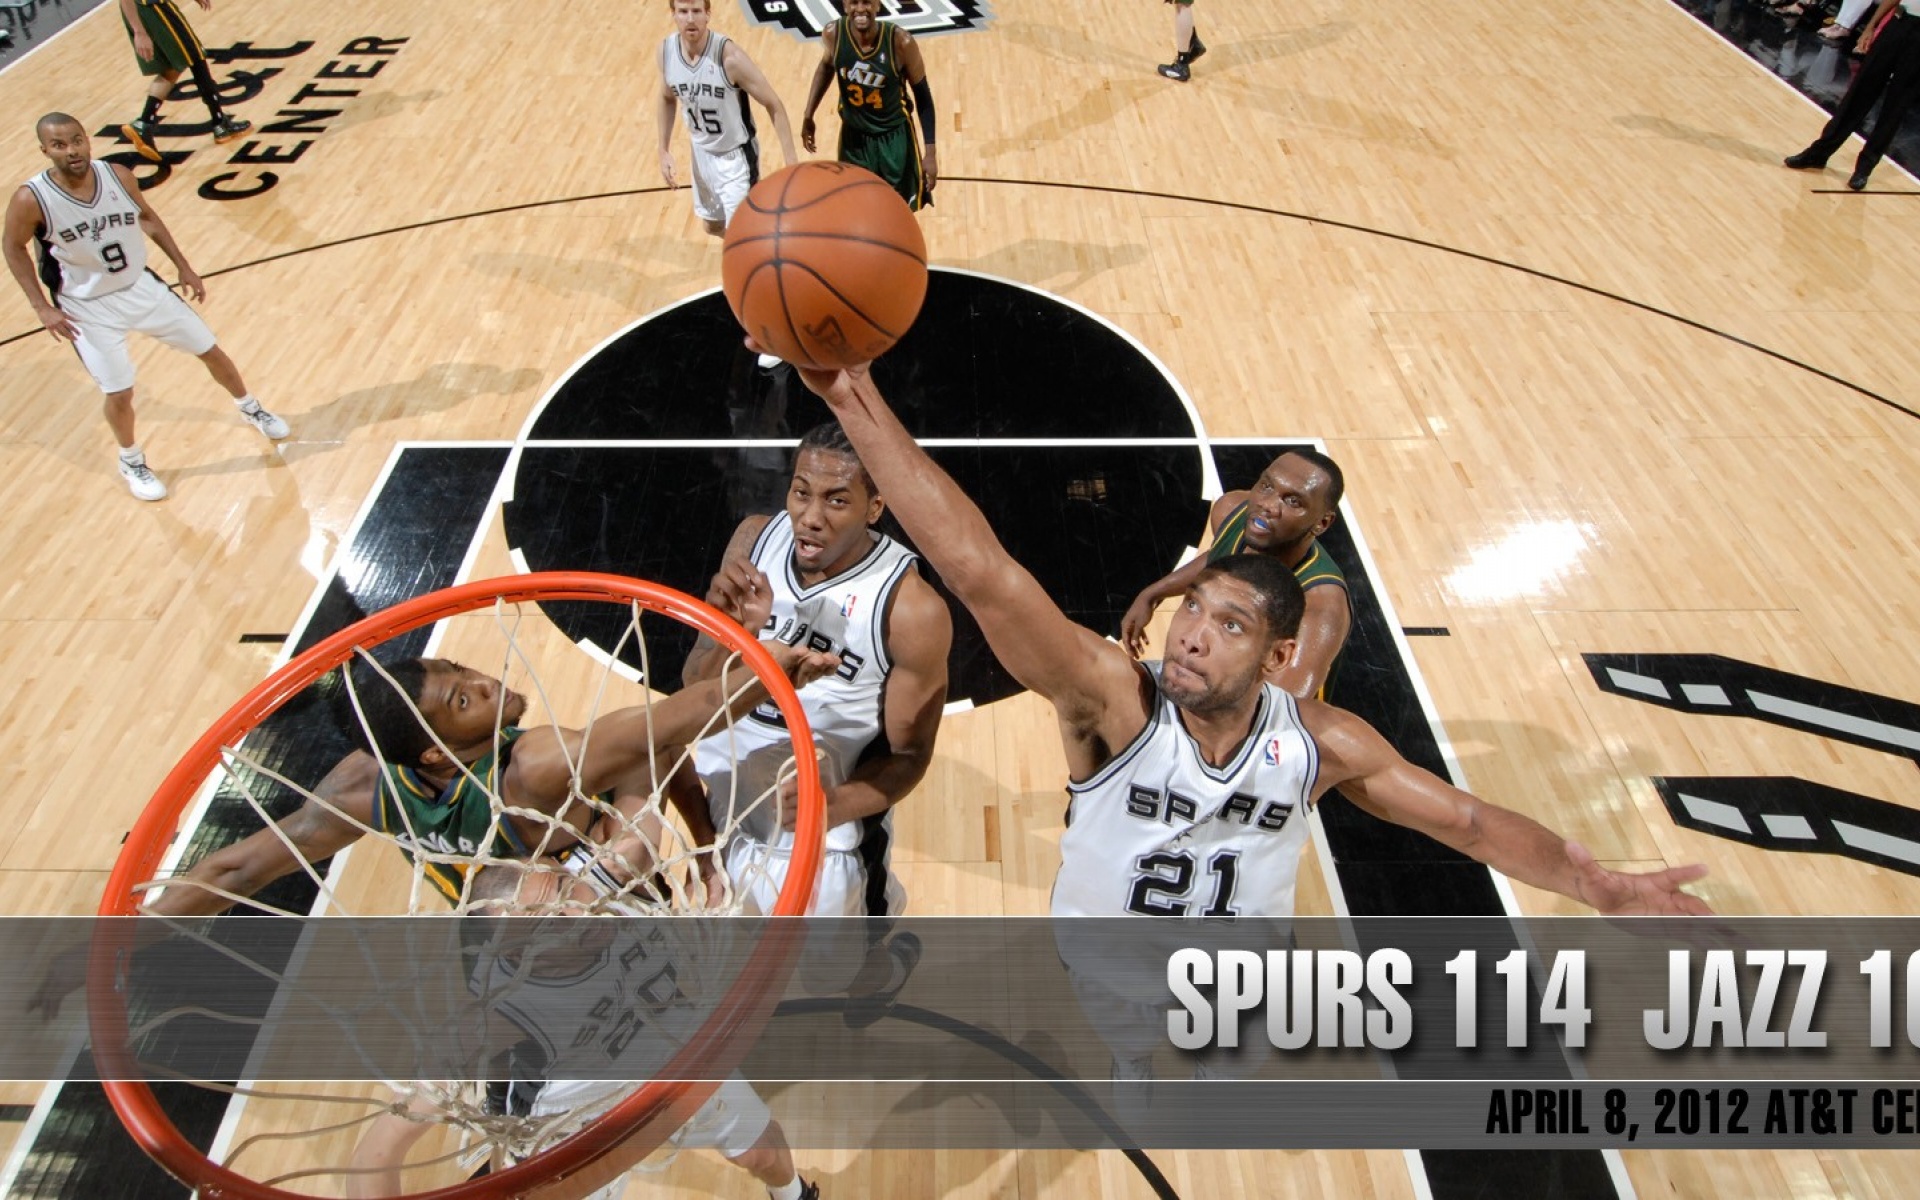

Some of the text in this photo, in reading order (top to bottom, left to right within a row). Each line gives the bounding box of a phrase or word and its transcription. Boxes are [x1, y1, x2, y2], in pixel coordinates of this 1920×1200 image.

[846, 84, 883, 109] 34
[197, 36, 411, 201] CENTER
[687, 107, 723, 135] 15
[58, 211, 135, 243] SPURS
[101, 242, 128, 273] 9
[1123, 848, 1241, 923] 21
